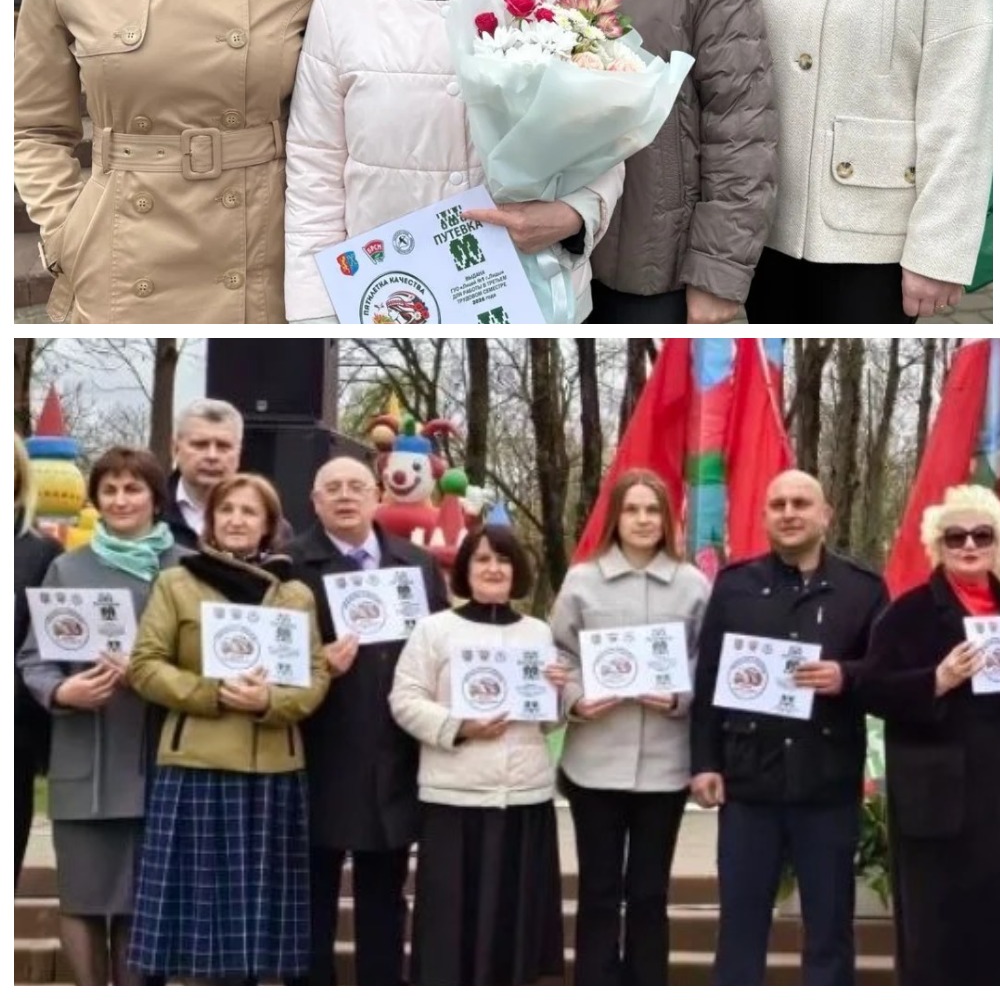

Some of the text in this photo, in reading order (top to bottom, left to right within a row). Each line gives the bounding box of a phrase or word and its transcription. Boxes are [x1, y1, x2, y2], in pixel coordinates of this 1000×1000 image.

[433, 220, 483, 245] ПУТЕВКА
[366, 243, 382, 254] БРСМ
[463, 284, 483, 295] РАБОТЫ
[487, 275, 507, 286] ТРЕТЬЕМ
[483, 282, 507, 295] СЕМЕСТРЕ
[363, 276, 426, 316] ПЯТИЛЕТКА КАЧЕСТВА
